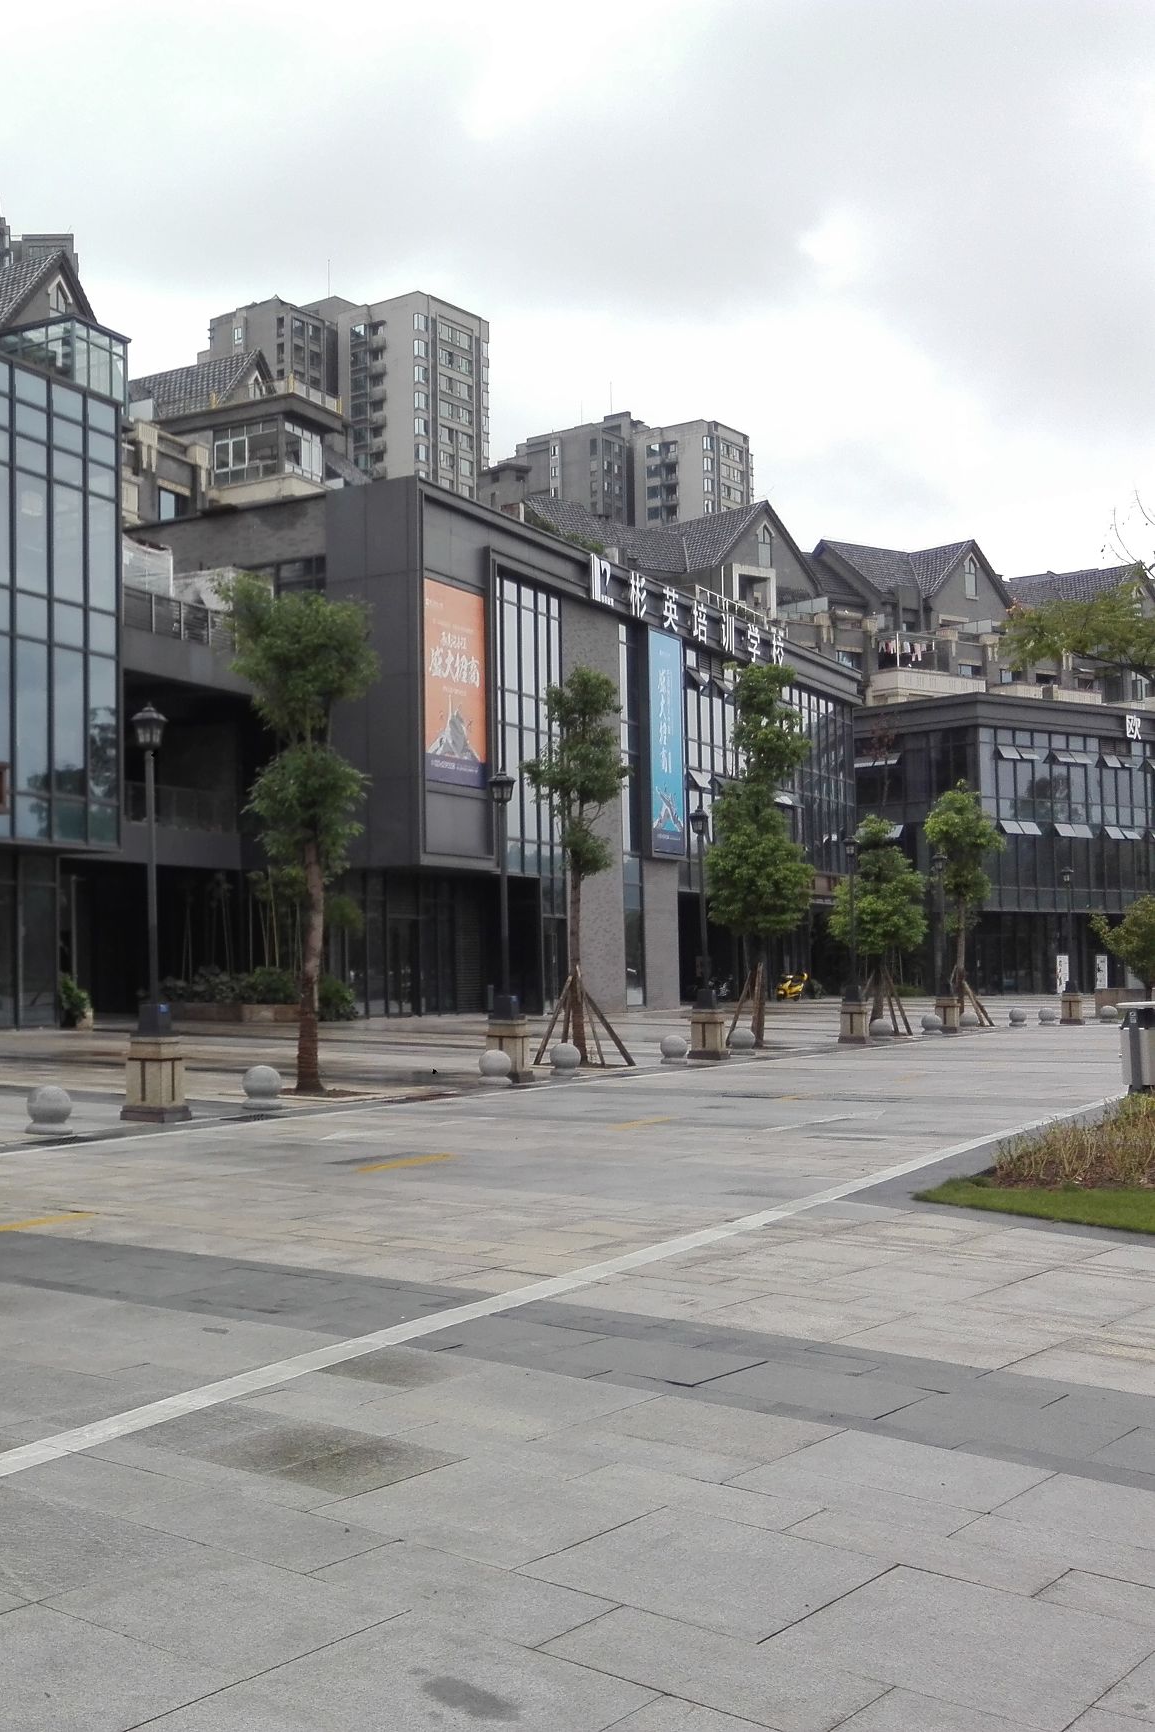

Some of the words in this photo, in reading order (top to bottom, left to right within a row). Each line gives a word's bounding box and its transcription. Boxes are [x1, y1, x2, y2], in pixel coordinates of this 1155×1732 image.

[630, 571, 785, 666] 彬英培训学校
[1126, 714, 1142, 740] 欧
